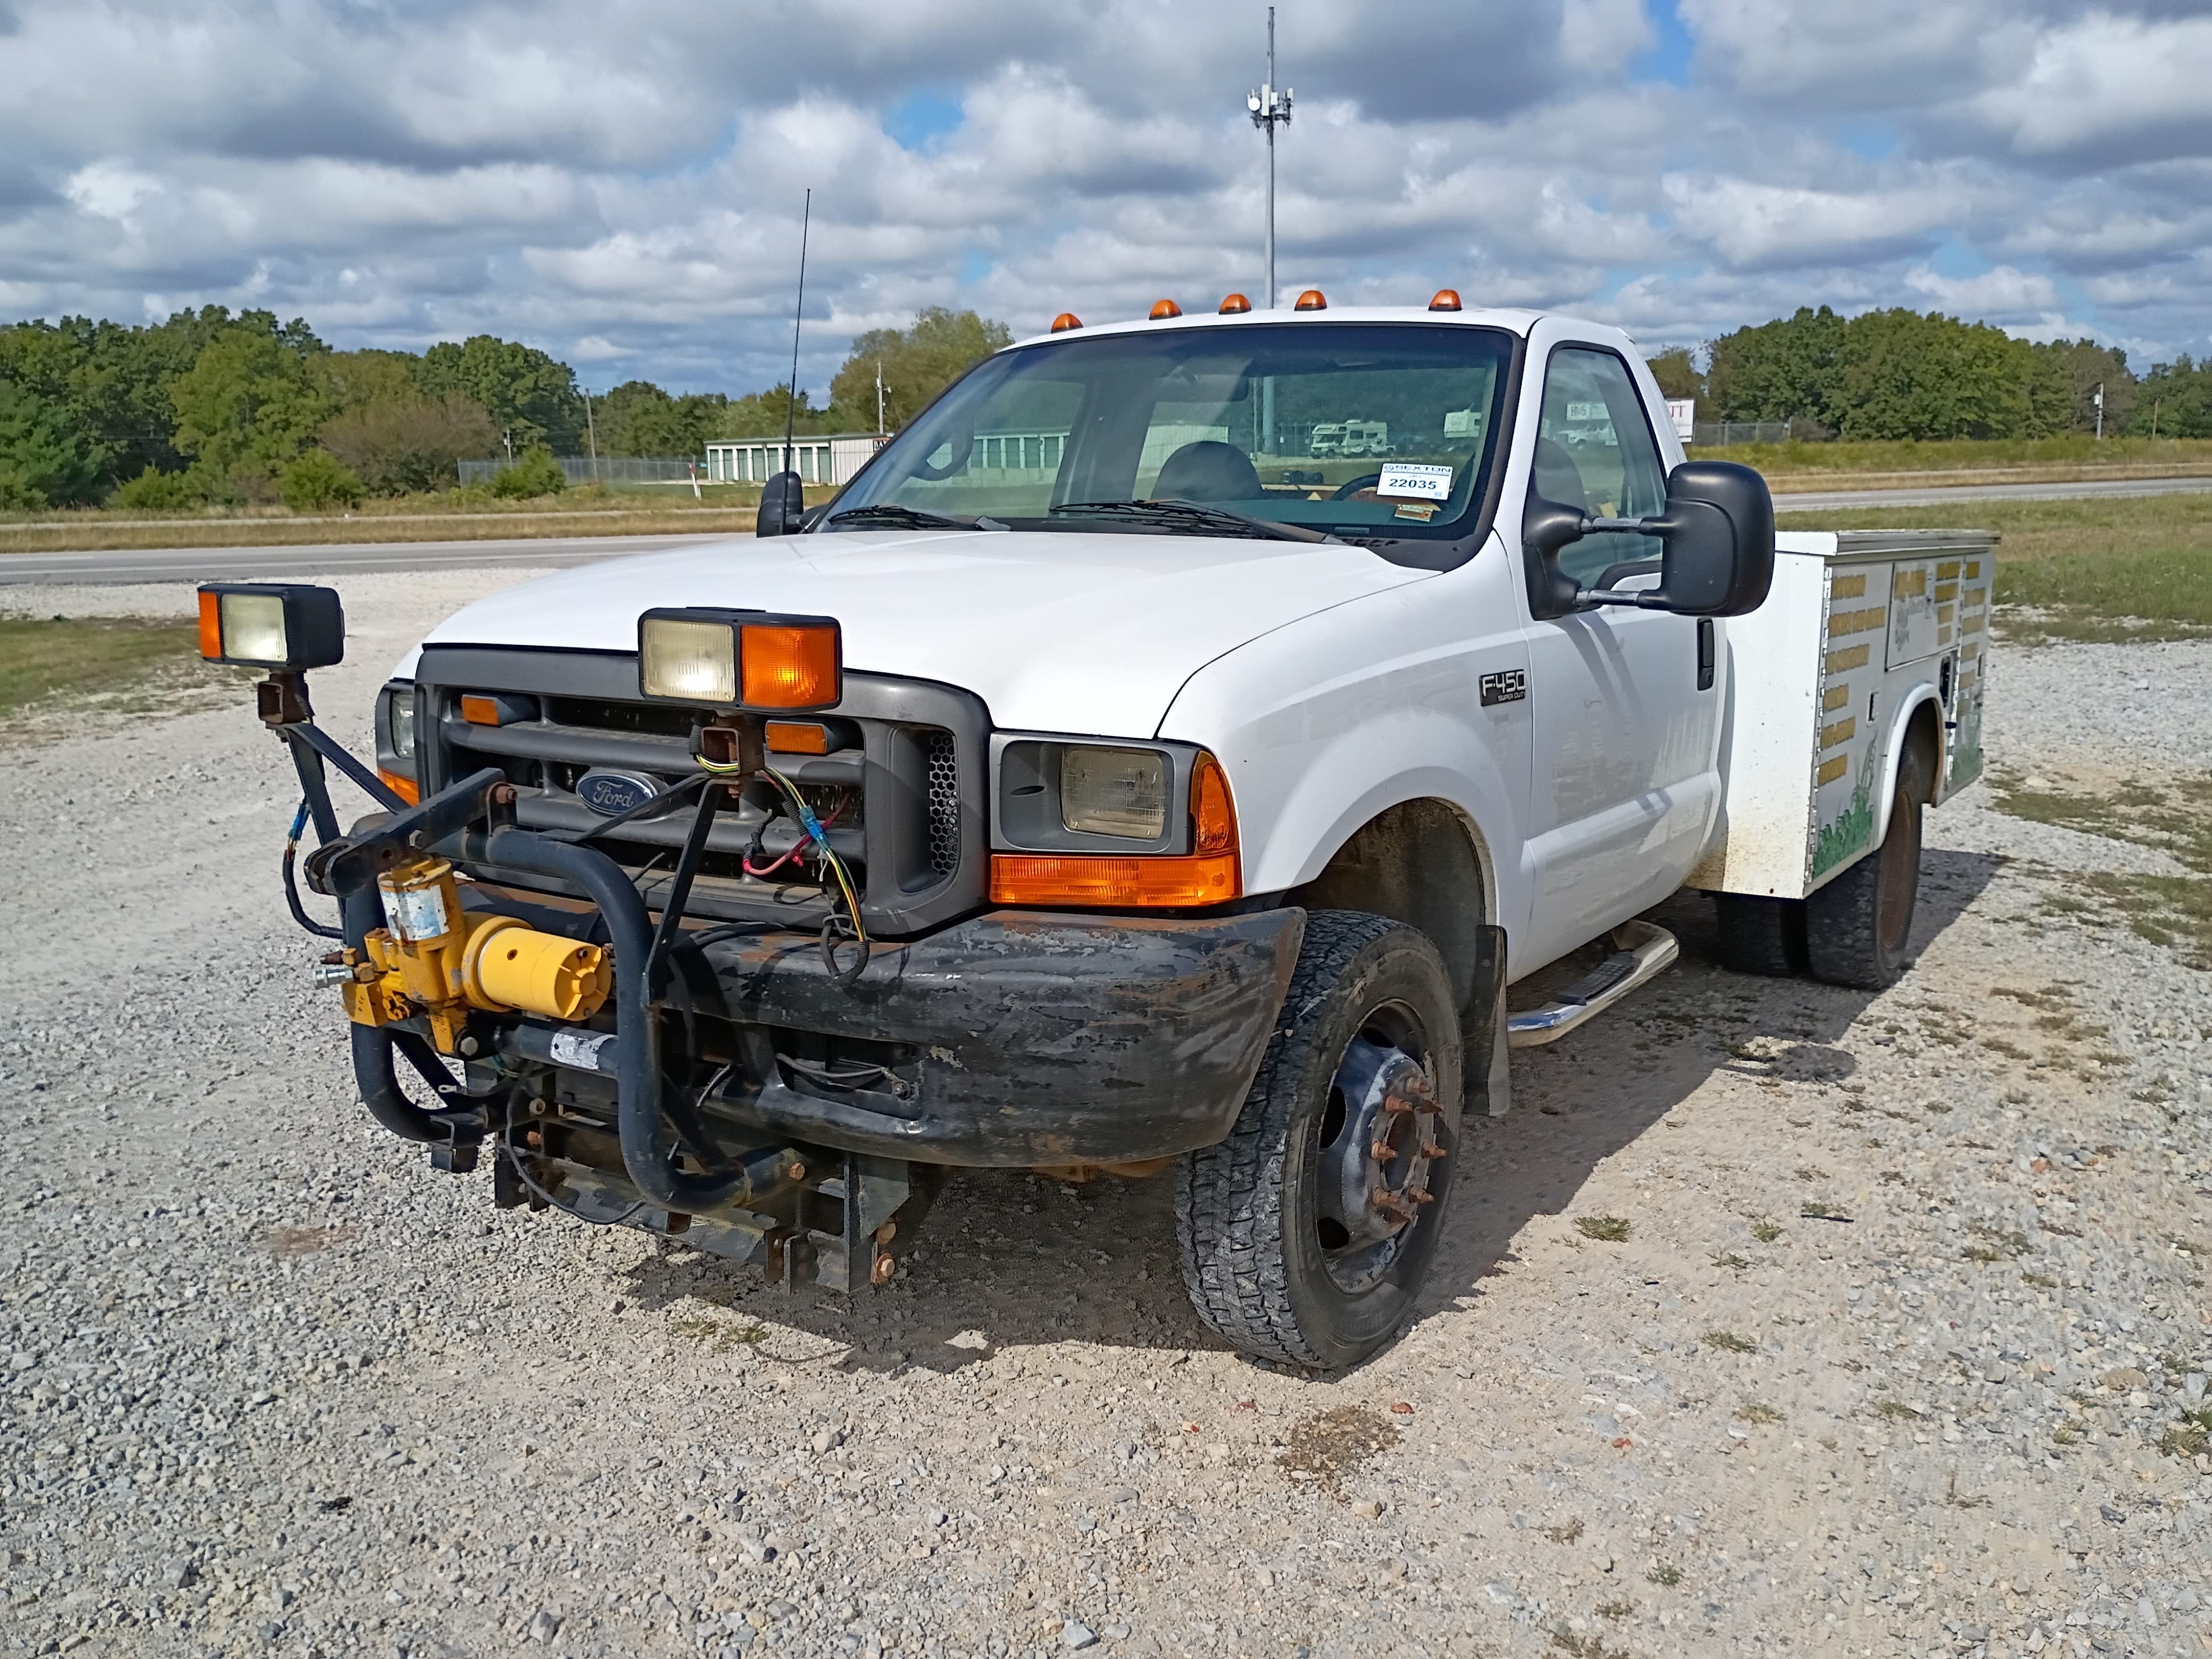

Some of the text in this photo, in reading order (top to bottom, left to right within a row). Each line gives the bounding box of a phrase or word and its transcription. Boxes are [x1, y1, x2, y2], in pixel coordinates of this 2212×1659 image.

[1389, 478, 1437, 490] 22035
[1498, 693, 1514, 702] SUPER
[592, 780, 634, 808] Ford
